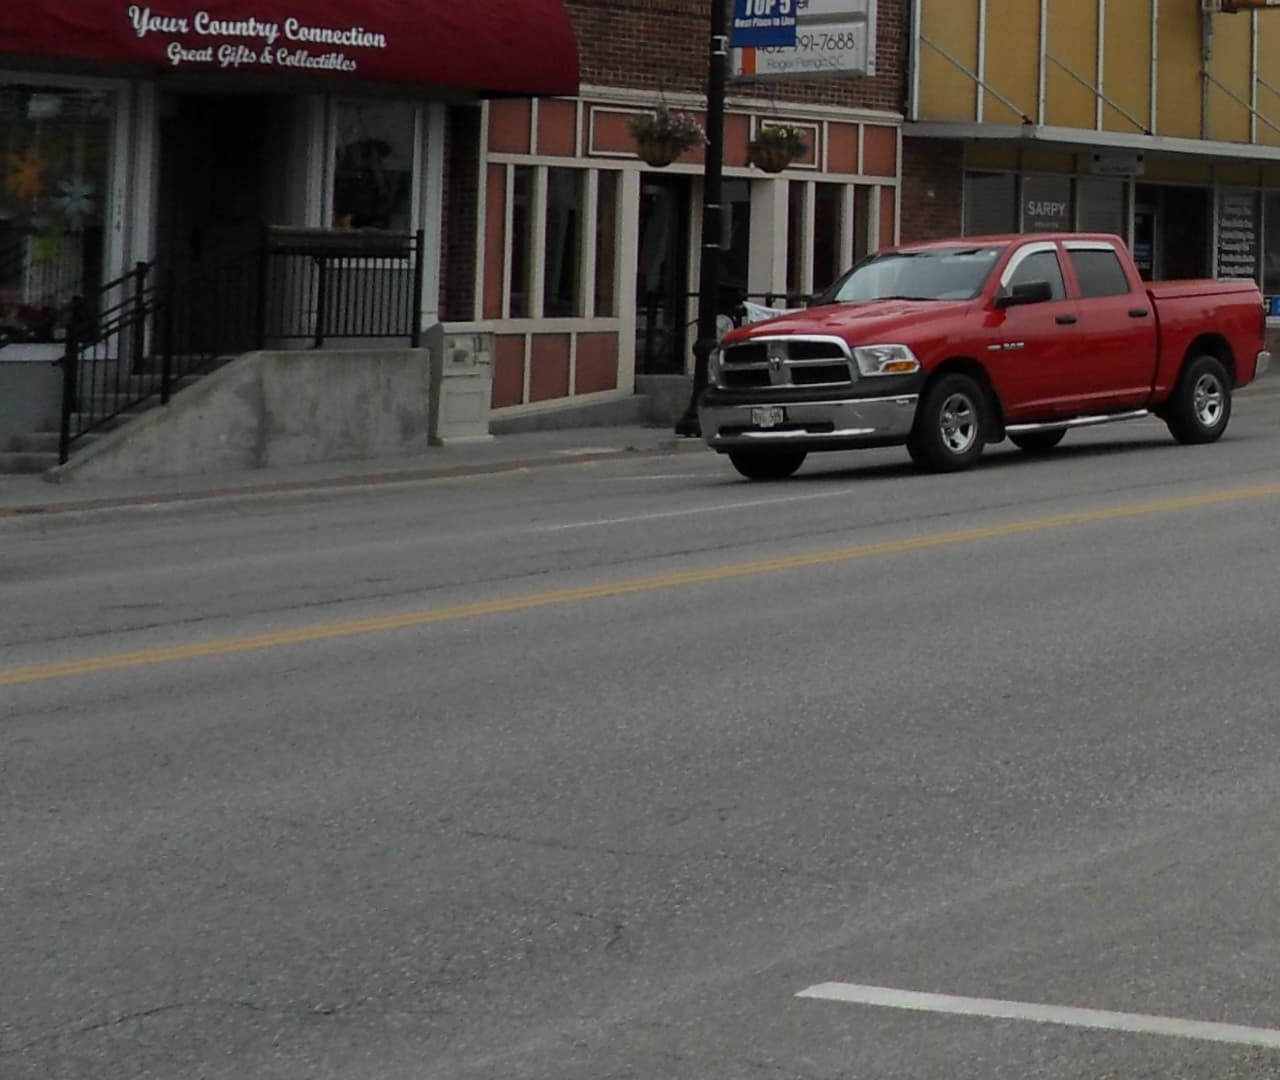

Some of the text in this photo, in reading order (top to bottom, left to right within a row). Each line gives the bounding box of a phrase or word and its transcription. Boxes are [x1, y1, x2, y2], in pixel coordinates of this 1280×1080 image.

[128, 5, 387, 48] Your Country Connection
[167, 42, 357, 71] Great Gifts & Collectibles
[1027, 201, 1066, 216] SARPY
